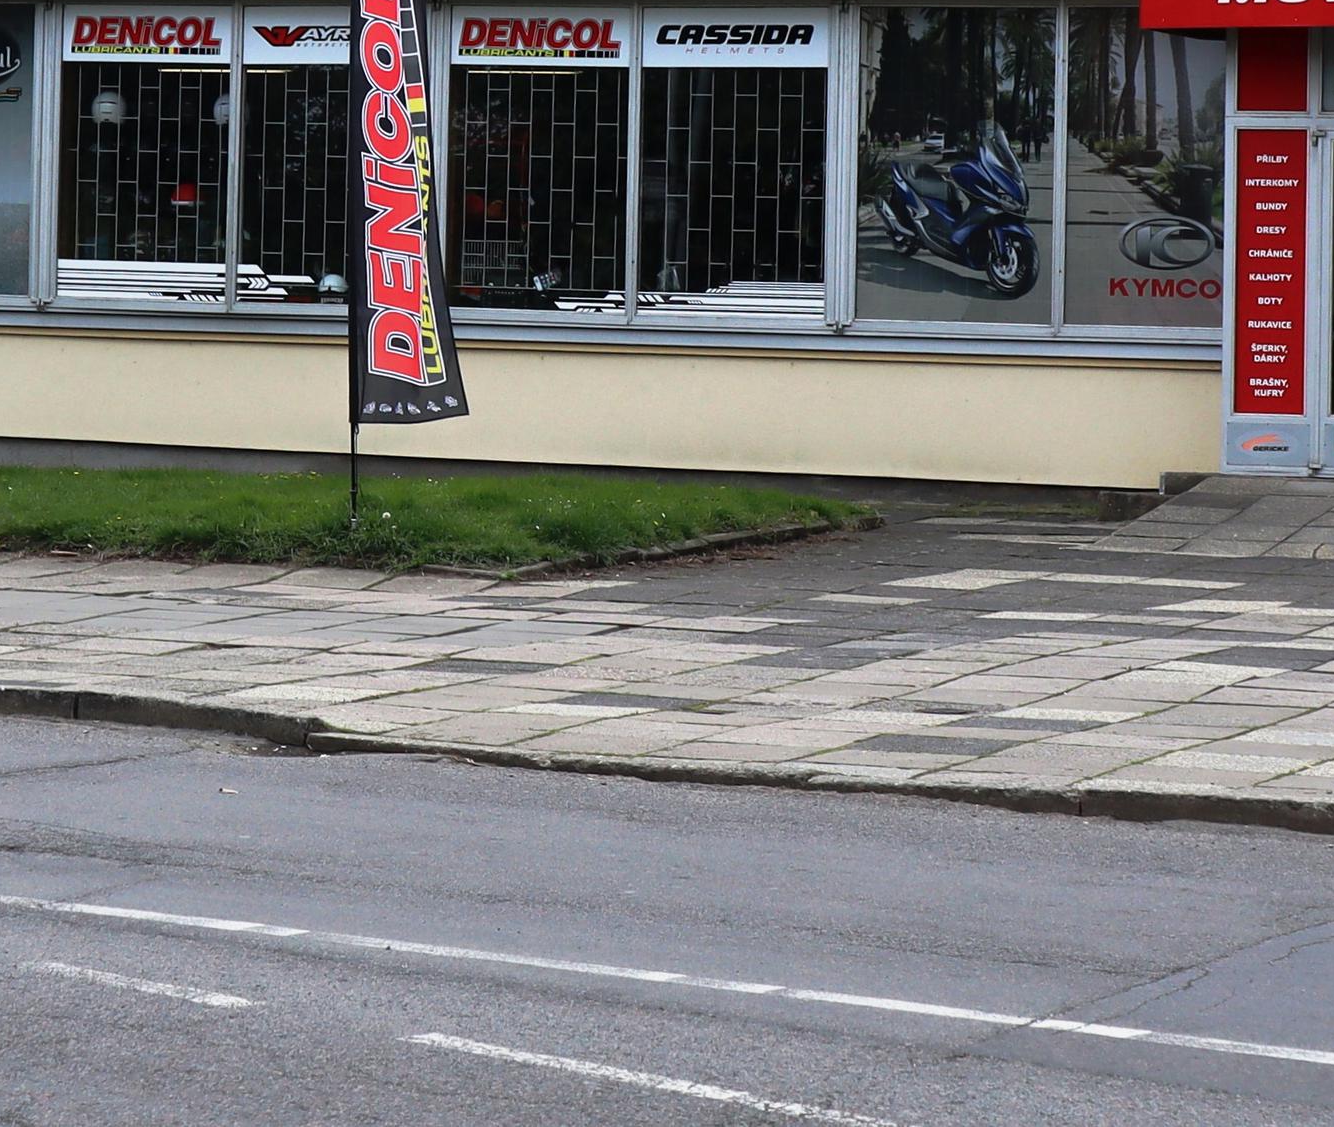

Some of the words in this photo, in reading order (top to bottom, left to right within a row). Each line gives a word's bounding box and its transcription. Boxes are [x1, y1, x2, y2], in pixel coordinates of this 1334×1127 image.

[252, 25, 351, 48] WAYR
[655, 24, 816, 46] CASSIDA
[74, 46, 160, 54] LUBRICANTS
[462, 48, 555, 57] LUBRICANTS
[685, 47, 786, 55] HELMETS
[1256, 154, 1288, 163] PŘILBY
[1245, 179, 1299, 187] INTERKOMY
[1256, 202, 1287, 210] BUNDY
[1256, 226, 1286, 234] DRESY
[1248, 248, 1293, 258] CHRÁNIČE
[1249, 273, 1292, 281] KALHOTY
[1108, 278, 1222, 300] KYMCO
[1258, 297, 1283, 305] BOTY
[1248, 320, 1292, 329] RUKAVICE
[1251, 343, 1288, 354] ŠPERKY,
[1254, 353, 1286, 362] DÁRKY
[1249, 377, 1289, 388] BRAŠNY,
[1254, 389, 1284, 397] KUFRY
